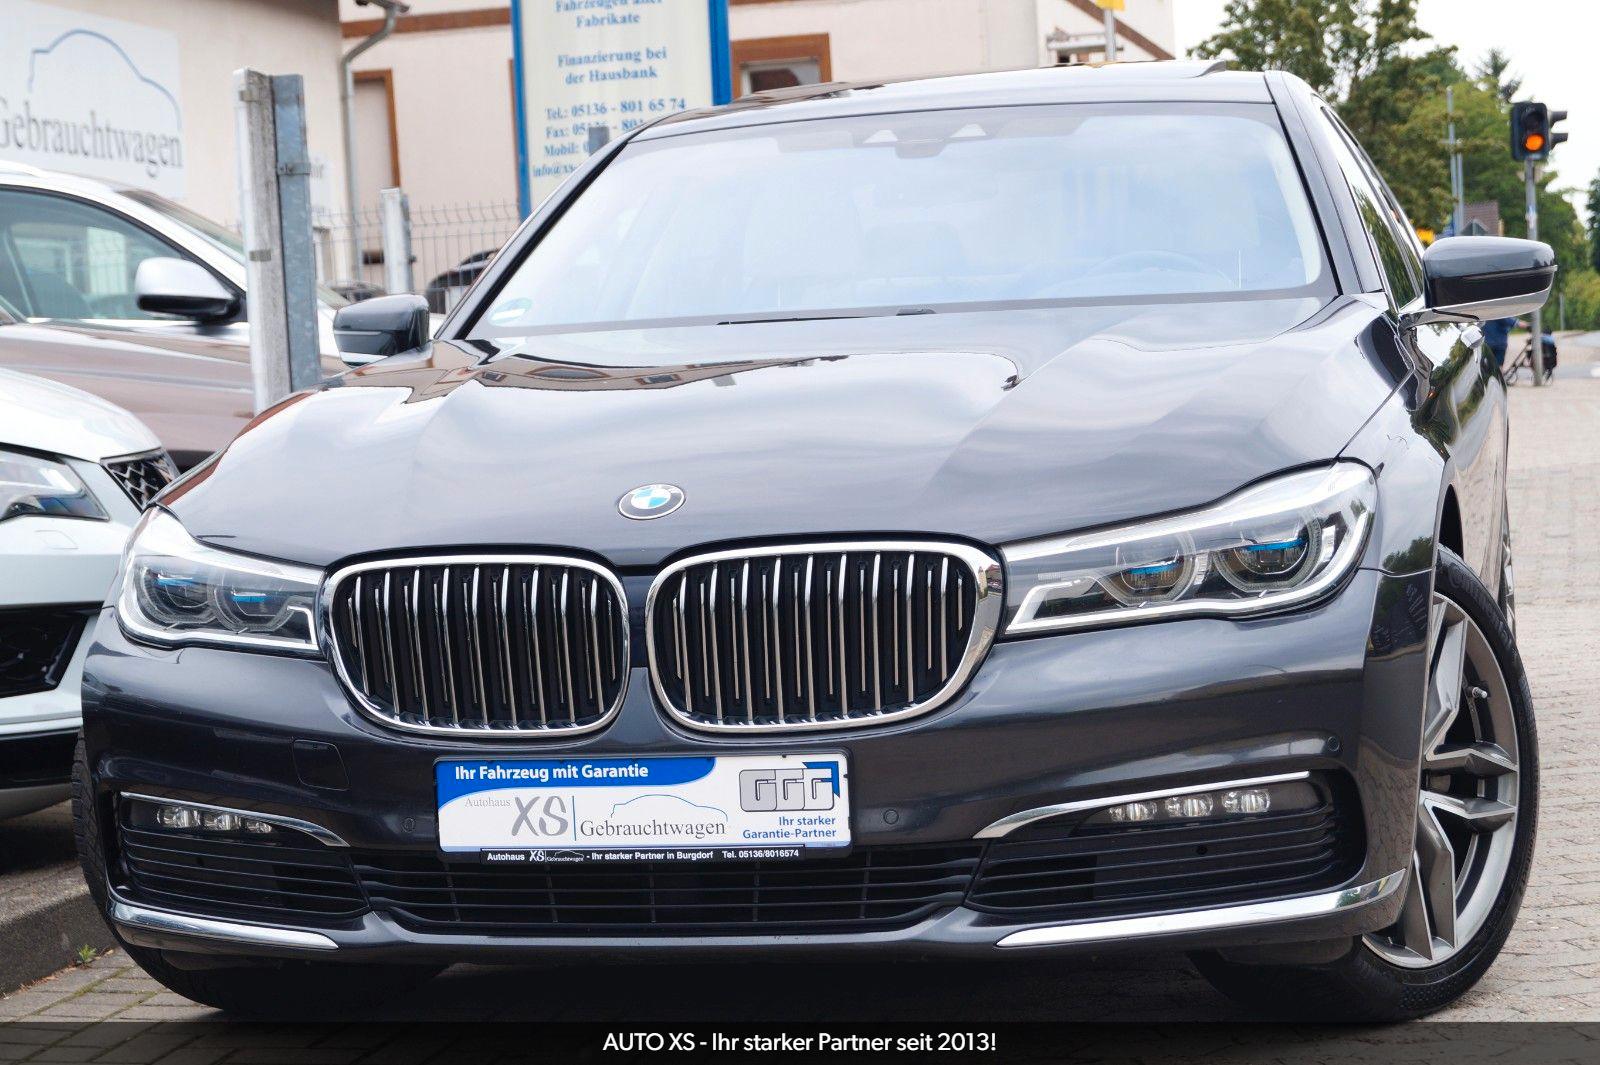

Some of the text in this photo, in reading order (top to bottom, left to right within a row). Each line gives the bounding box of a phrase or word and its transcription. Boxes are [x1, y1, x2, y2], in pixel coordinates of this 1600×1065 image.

[576, 14, 640, 28] Fabrikate
[557, 47, 667, 67] Finanzierung bei
[565, 66, 658, 85] der Hausbank
[571, 102, 607, 117] 05136
[620, 100, 642, 112] 801
[650, 100, 664, 111] 65
[670, 98, 686, 110] 74
[546, 126, 569, 139] Fax:
[544, 142, 579, 157] Mobil:
[455, 763, 649, 782] Ihr Fahrzeug mit Garantie
[464, 795, 569, 837] Autohaus XS
[778, 815, 836, 826] Ihr starker
[580, 819, 726, 839] Gebrauchtwagen
[742, 828, 837, 840] Garantie-Partner
[487, 852, 525, 861] Autohaus
[529, 850, 545, 862] XS
[591, 852, 603, 860] Ihr
[604, 852, 633, 860] starker
[635, 851, 664, 860] Partner
[667, 851, 674, 859] in
[676, 851, 714, 861] Burgdorf
[722, 850, 737, 858] Tel.
[738, 849, 799, 858] 05136/8016574
